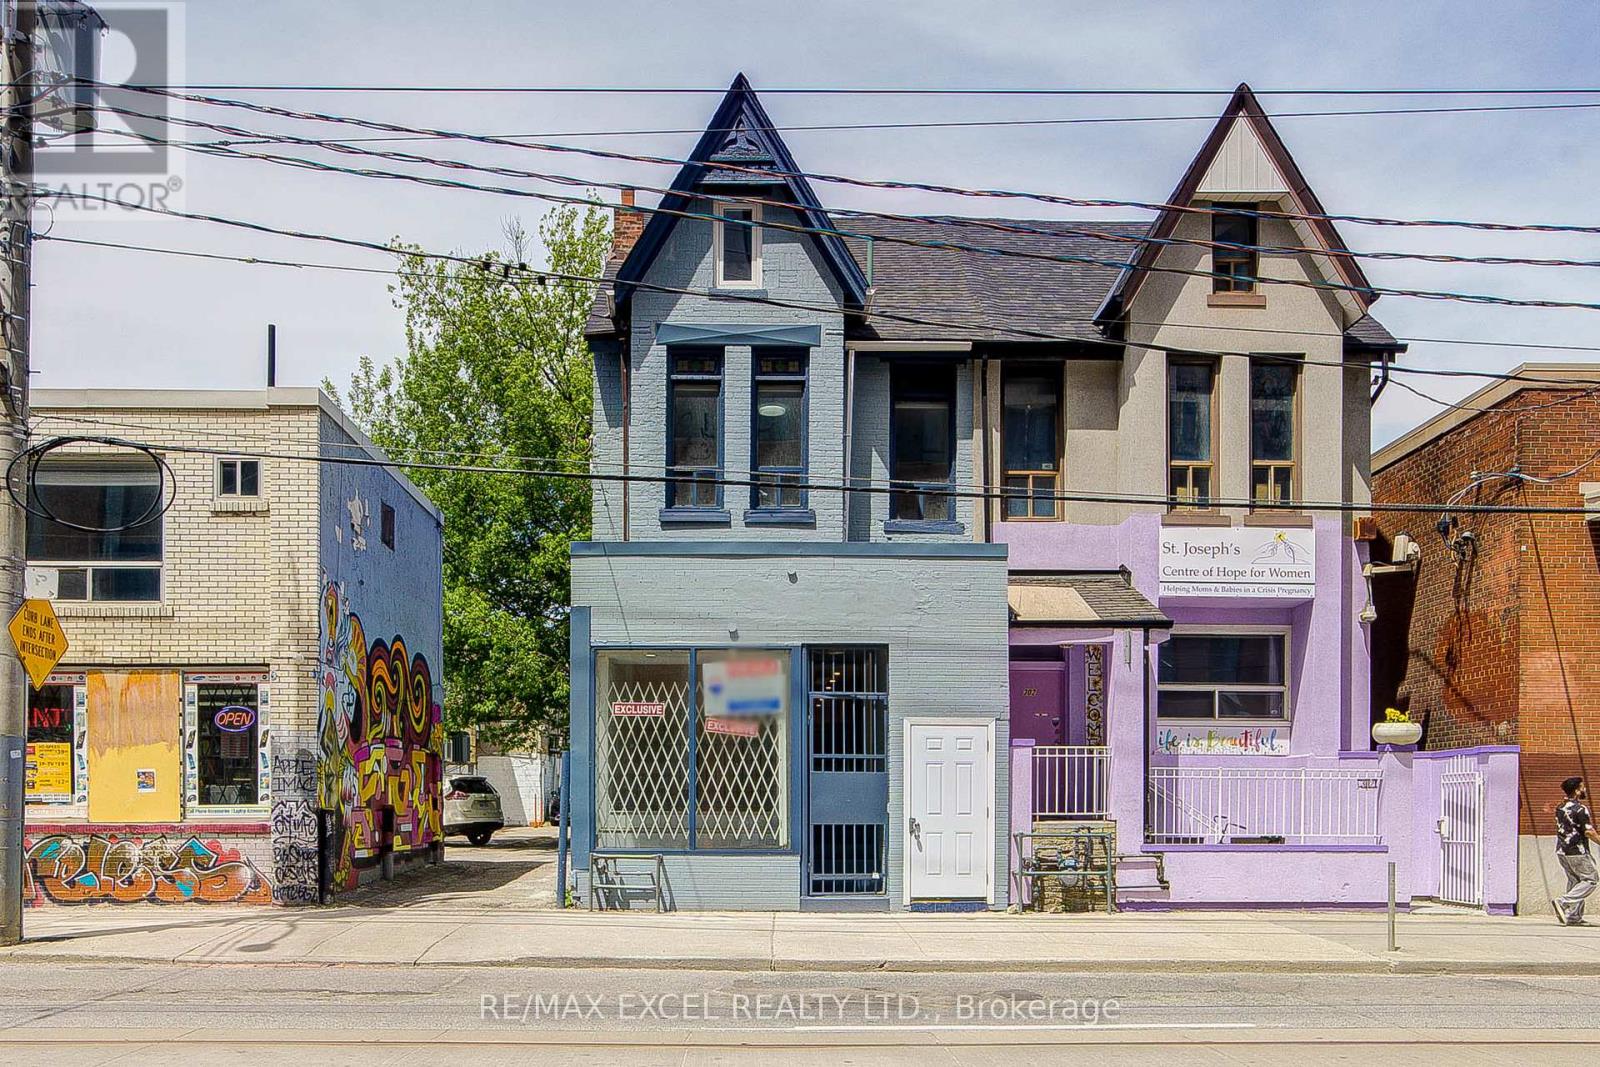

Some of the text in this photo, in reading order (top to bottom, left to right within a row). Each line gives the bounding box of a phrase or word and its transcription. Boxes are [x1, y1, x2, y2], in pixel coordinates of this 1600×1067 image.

[1162, 541, 1241, 559] St. Joseph's
[1162, 566, 1311, 580] Centre of Hope for Women
[1163, 585, 1191, 595] Helping
[1221, 585, 1243, 593] Babies
[1257, 586, 1276, 594] Crisis
[1277, 587, 1312, 595] Pregnancy
[23, 608, 54, 630] CURB LANE
[22, 624, 55, 645] ENDS AFTER
[20, 640, 57, 662] INTERSECTION
[217, 712, 252, 725] OPEN
[614, 704, 663, 715] EXCLUSIVE
[1157, 729, 1181, 751] ife
[273, 755, 315, 776] APPLE
[272, 776, 317, 793] IMAC
